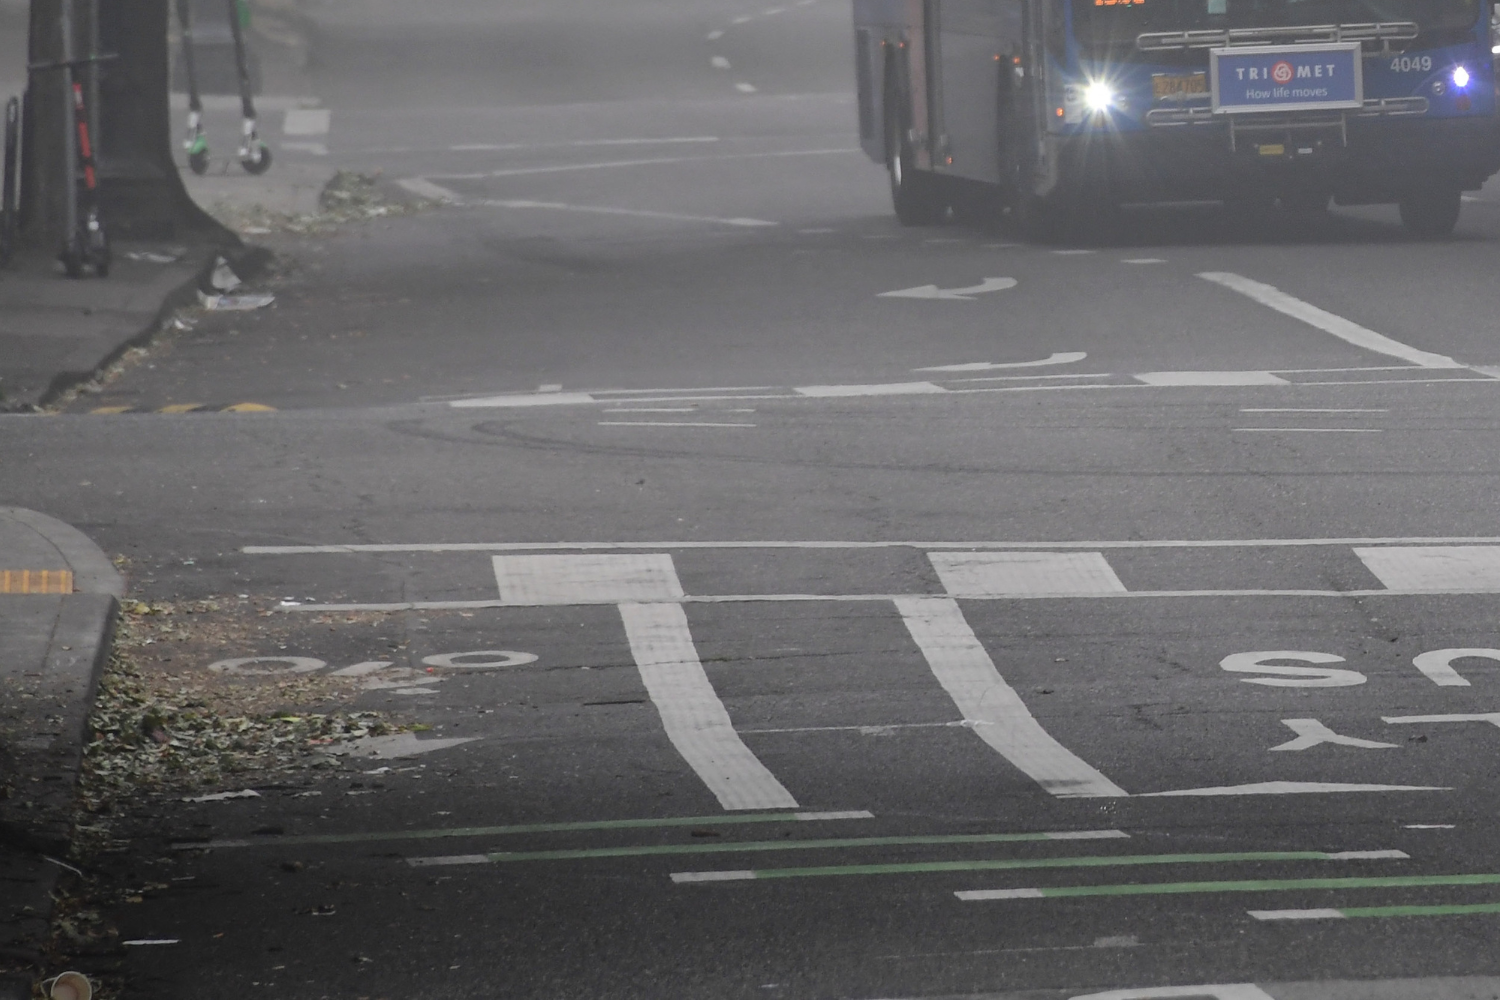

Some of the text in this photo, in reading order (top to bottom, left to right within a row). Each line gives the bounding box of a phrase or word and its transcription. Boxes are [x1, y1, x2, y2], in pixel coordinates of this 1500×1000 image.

[1236, 64, 1335, 80] TRI MET
[1390, 56, 1432, 73] 4049
[1246, 86, 1328, 99] How life moves
